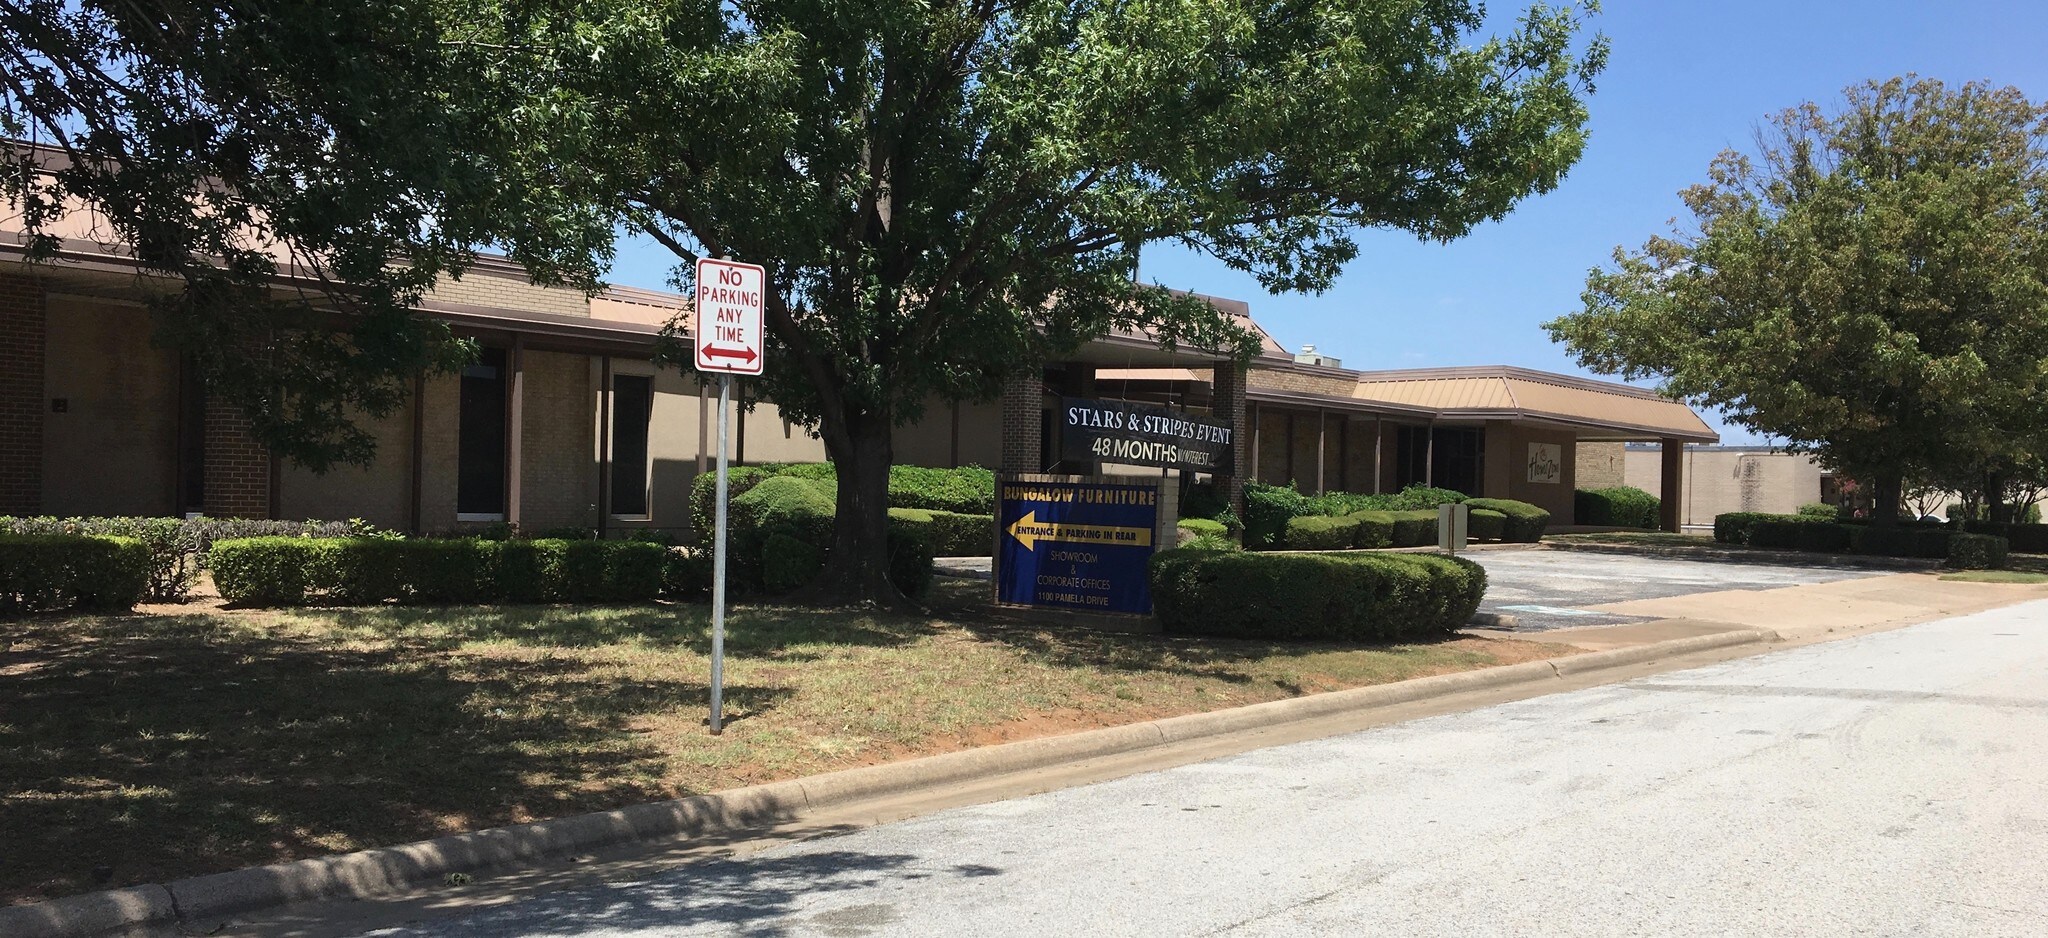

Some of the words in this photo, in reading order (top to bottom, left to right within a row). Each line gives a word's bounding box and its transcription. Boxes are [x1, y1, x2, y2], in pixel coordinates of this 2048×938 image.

[719, 269, 743, 287] NO
[701, 286, 758, 307] PARKING
[716, 306, 743, 324] ANY
[715, 325, 744, 343] TIME
[1068, 406, 1124, 430] STARS
[1127, 413, 1140, 432] &
[1143, 415, 1196, 439] STRIPES
[1196, 423, 1232, 445] EVENT
[1092, 437, 1111, 457] 48
[1112, 438, 1177, 463] MONTHS
[1003, 485, 1074, 503] BUNGALOW
[1078, 488, 1155, 506] FURNITURE
[1017, 525, 1055, 537] ENTRANCE
[1056, 528, 1063, 537] &
[1066, 528, 1101, 540] PARKING
[1103, 530, 1113, 540] IN
[1115, 531, 1136, 541] REAR
[1050, 550, 1098, 564] SHOWROOM
[1070, 564, 1076, 575] &
[1037, 574, 1079, 588] CORPORATE
[1081, 578, 1111, 591] OFFICES
[1038, 591, 1053, 601] 1100
[1055, 593, 1085, 605] PAMELA
[1086, 595, 1109, 607] DRIVE
